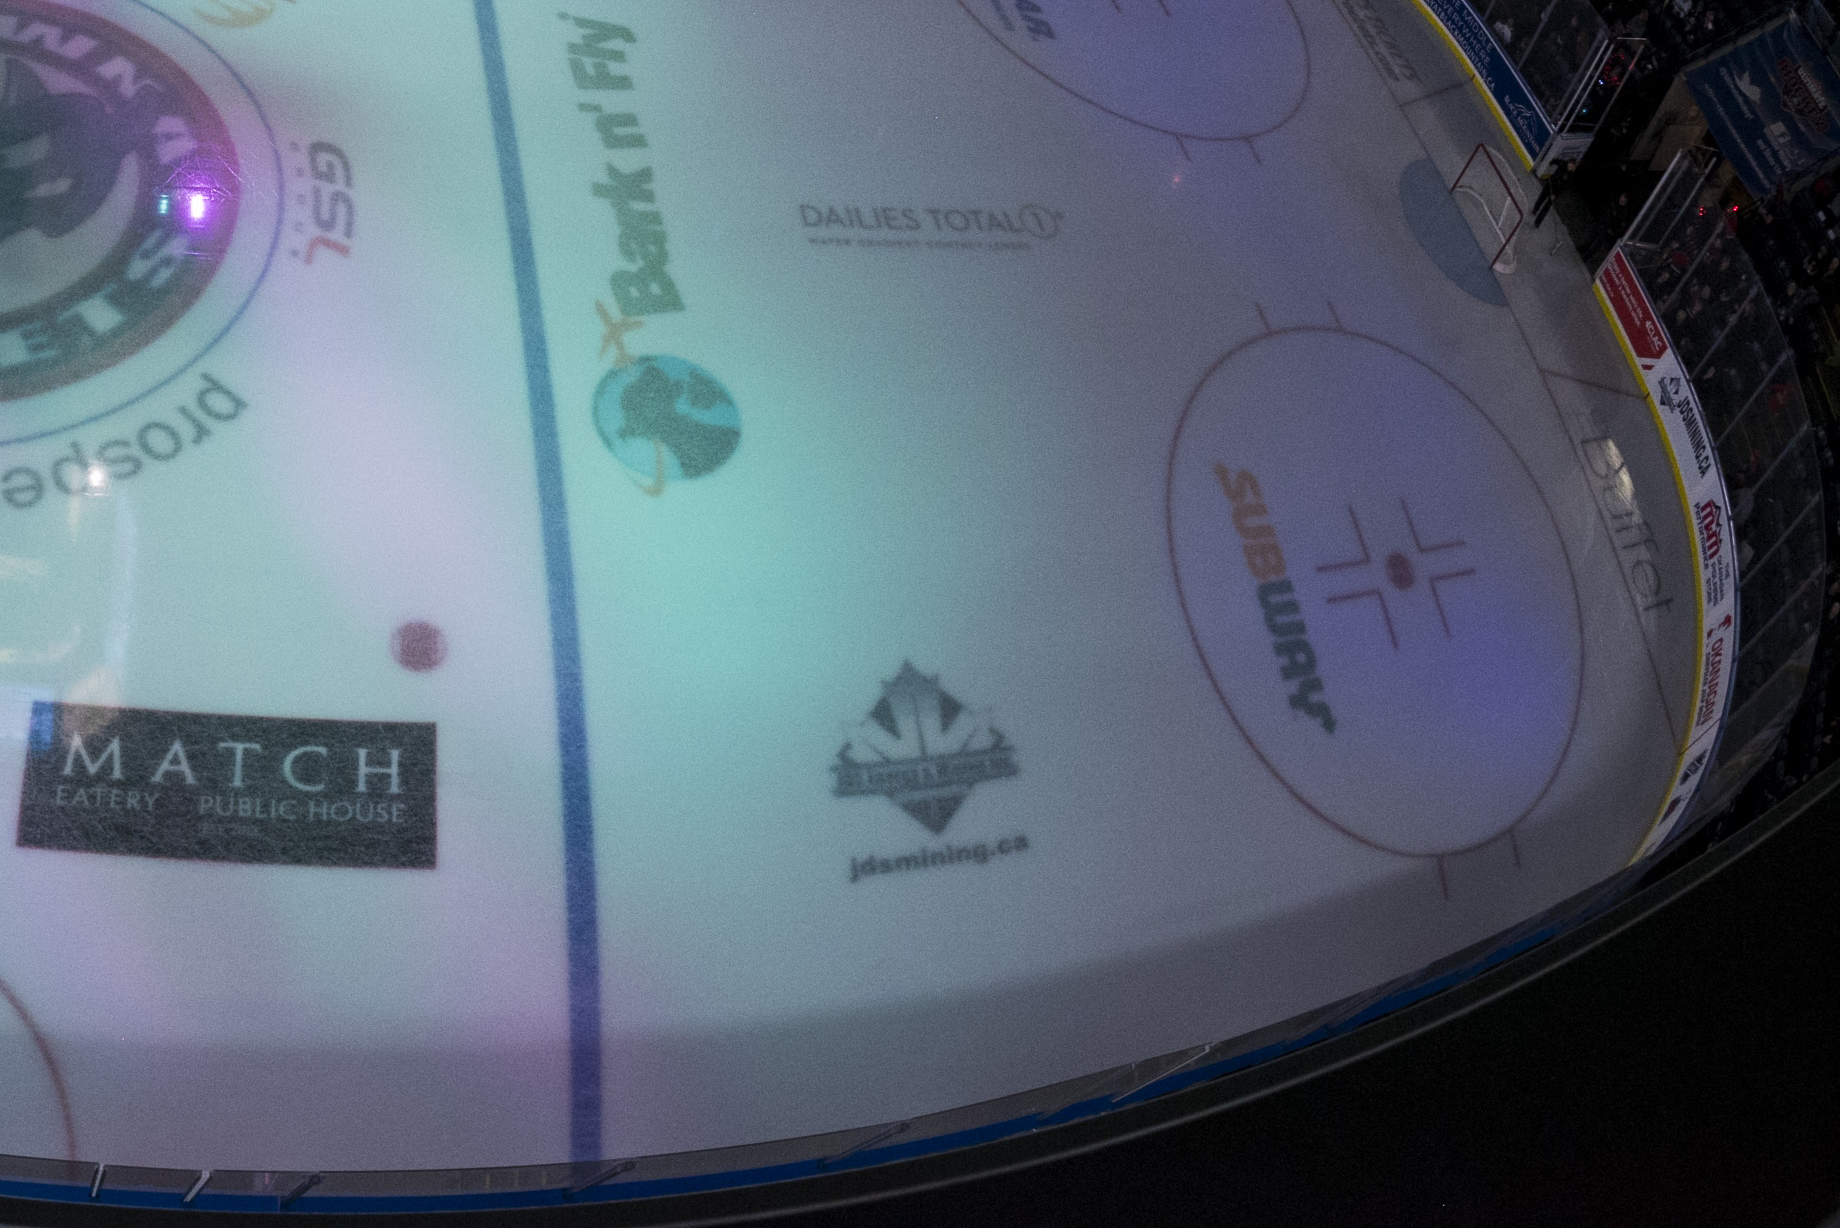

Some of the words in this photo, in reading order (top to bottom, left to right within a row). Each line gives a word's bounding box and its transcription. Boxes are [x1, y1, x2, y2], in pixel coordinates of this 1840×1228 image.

[566, 13, 638, 92] Fly
[1462, 10, 1493, 52] MIDDLE
[1518, 116, 1541, 154] MOUNTAIN
[303, 138, 355, 265] GSL
[799, 204, 922, 233] DAILIES
[1648, 321, 1663, 351] CLAC
[1676, 395, 1712, 478] JDSMINING.CA
[1580, 437, 1674, 613] Buffet
[1693, 501, 1710, 570] Performance
[1214, 461, 1338, 735] SUBWAY
[1700, 636, 1724, 726] OKANAGAN
[62, 732, 405, 795] MATCH
[57, 783, 161, 813] EATERY
[198, 794, 298, 822] PUBLIC
[306, 799, 407, 824] HOUSE
[849, 833, 1031, 884] jdsmining.ca
